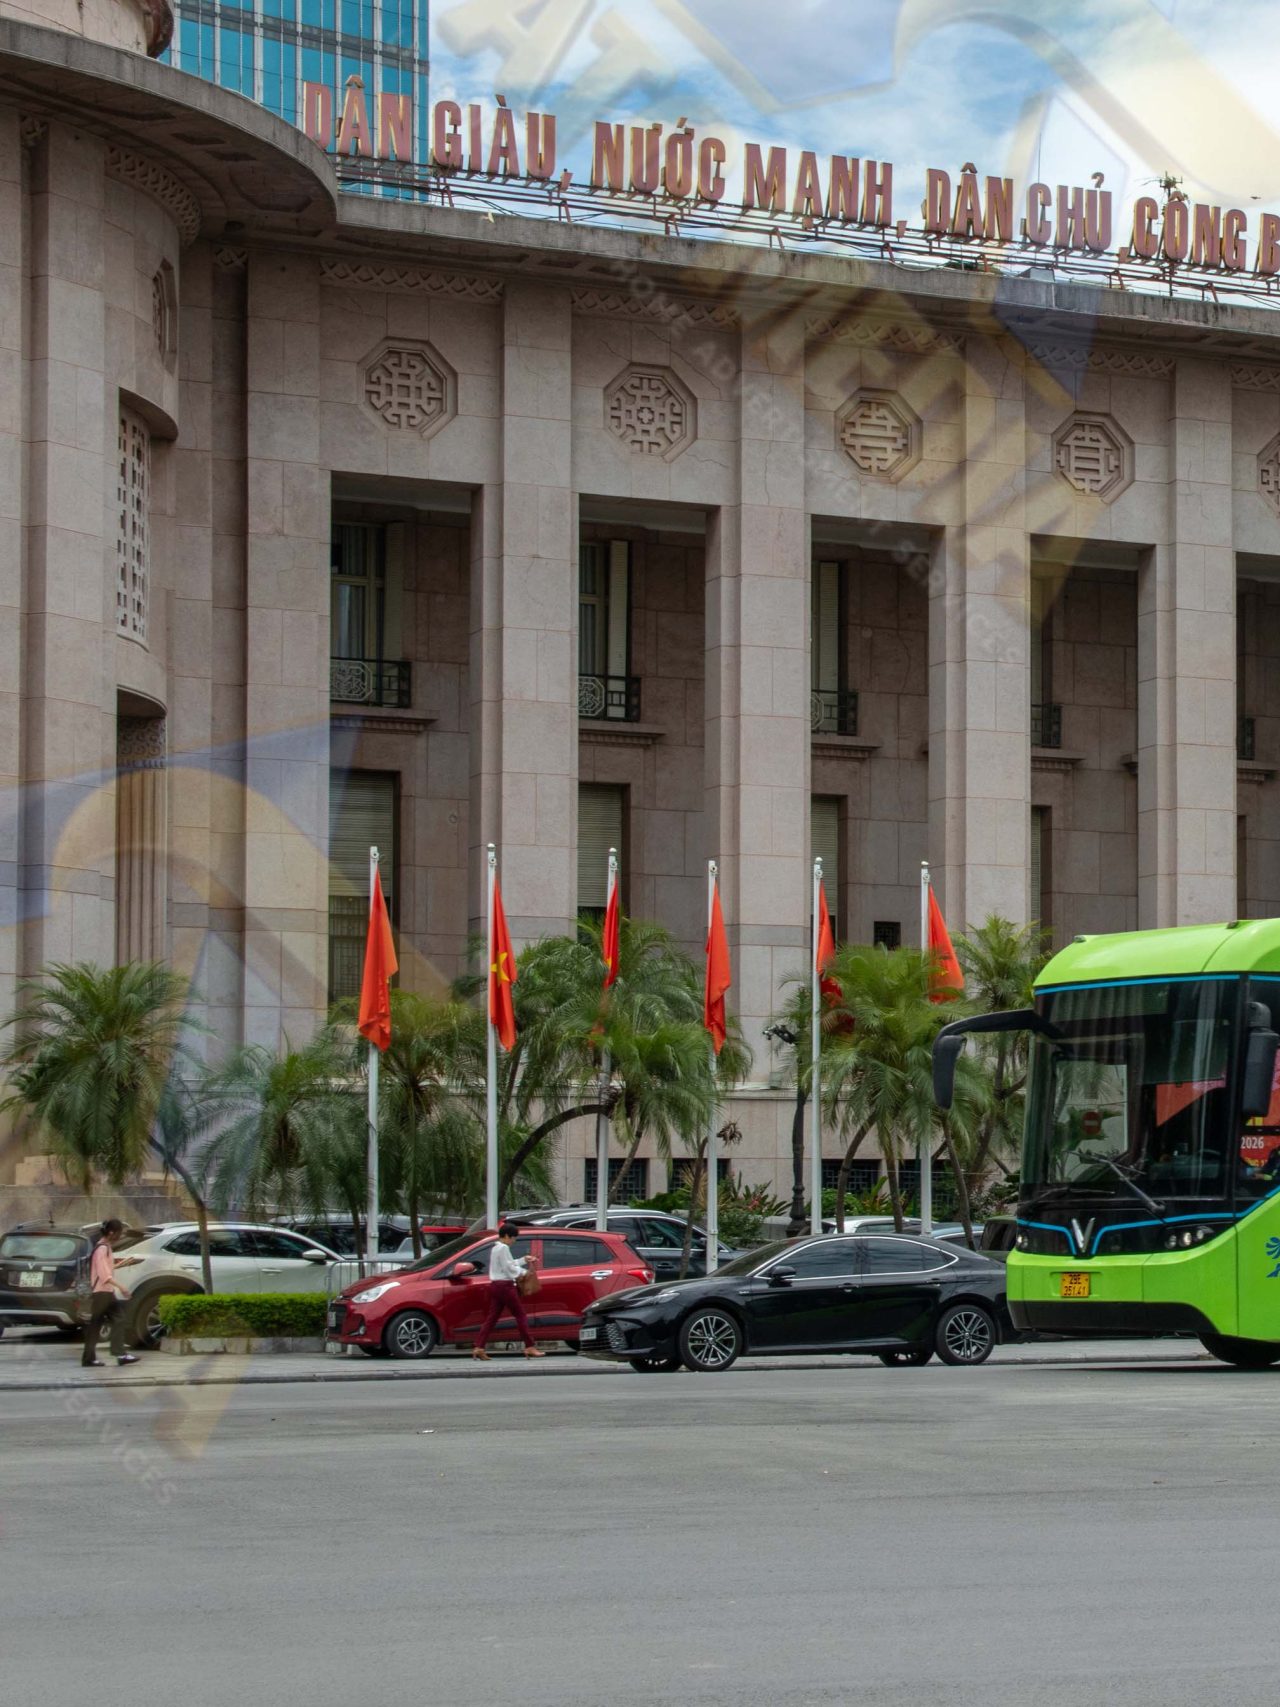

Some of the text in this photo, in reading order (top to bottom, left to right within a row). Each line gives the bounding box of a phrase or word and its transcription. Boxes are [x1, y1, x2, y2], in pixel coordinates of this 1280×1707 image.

[303, 74, 411, 163] DÂN
[593, 117, 726, 200] NƯỚC
[926, 162, 1013, 240] DÂN
[1133, 191, 1248, 271] CÔNG
